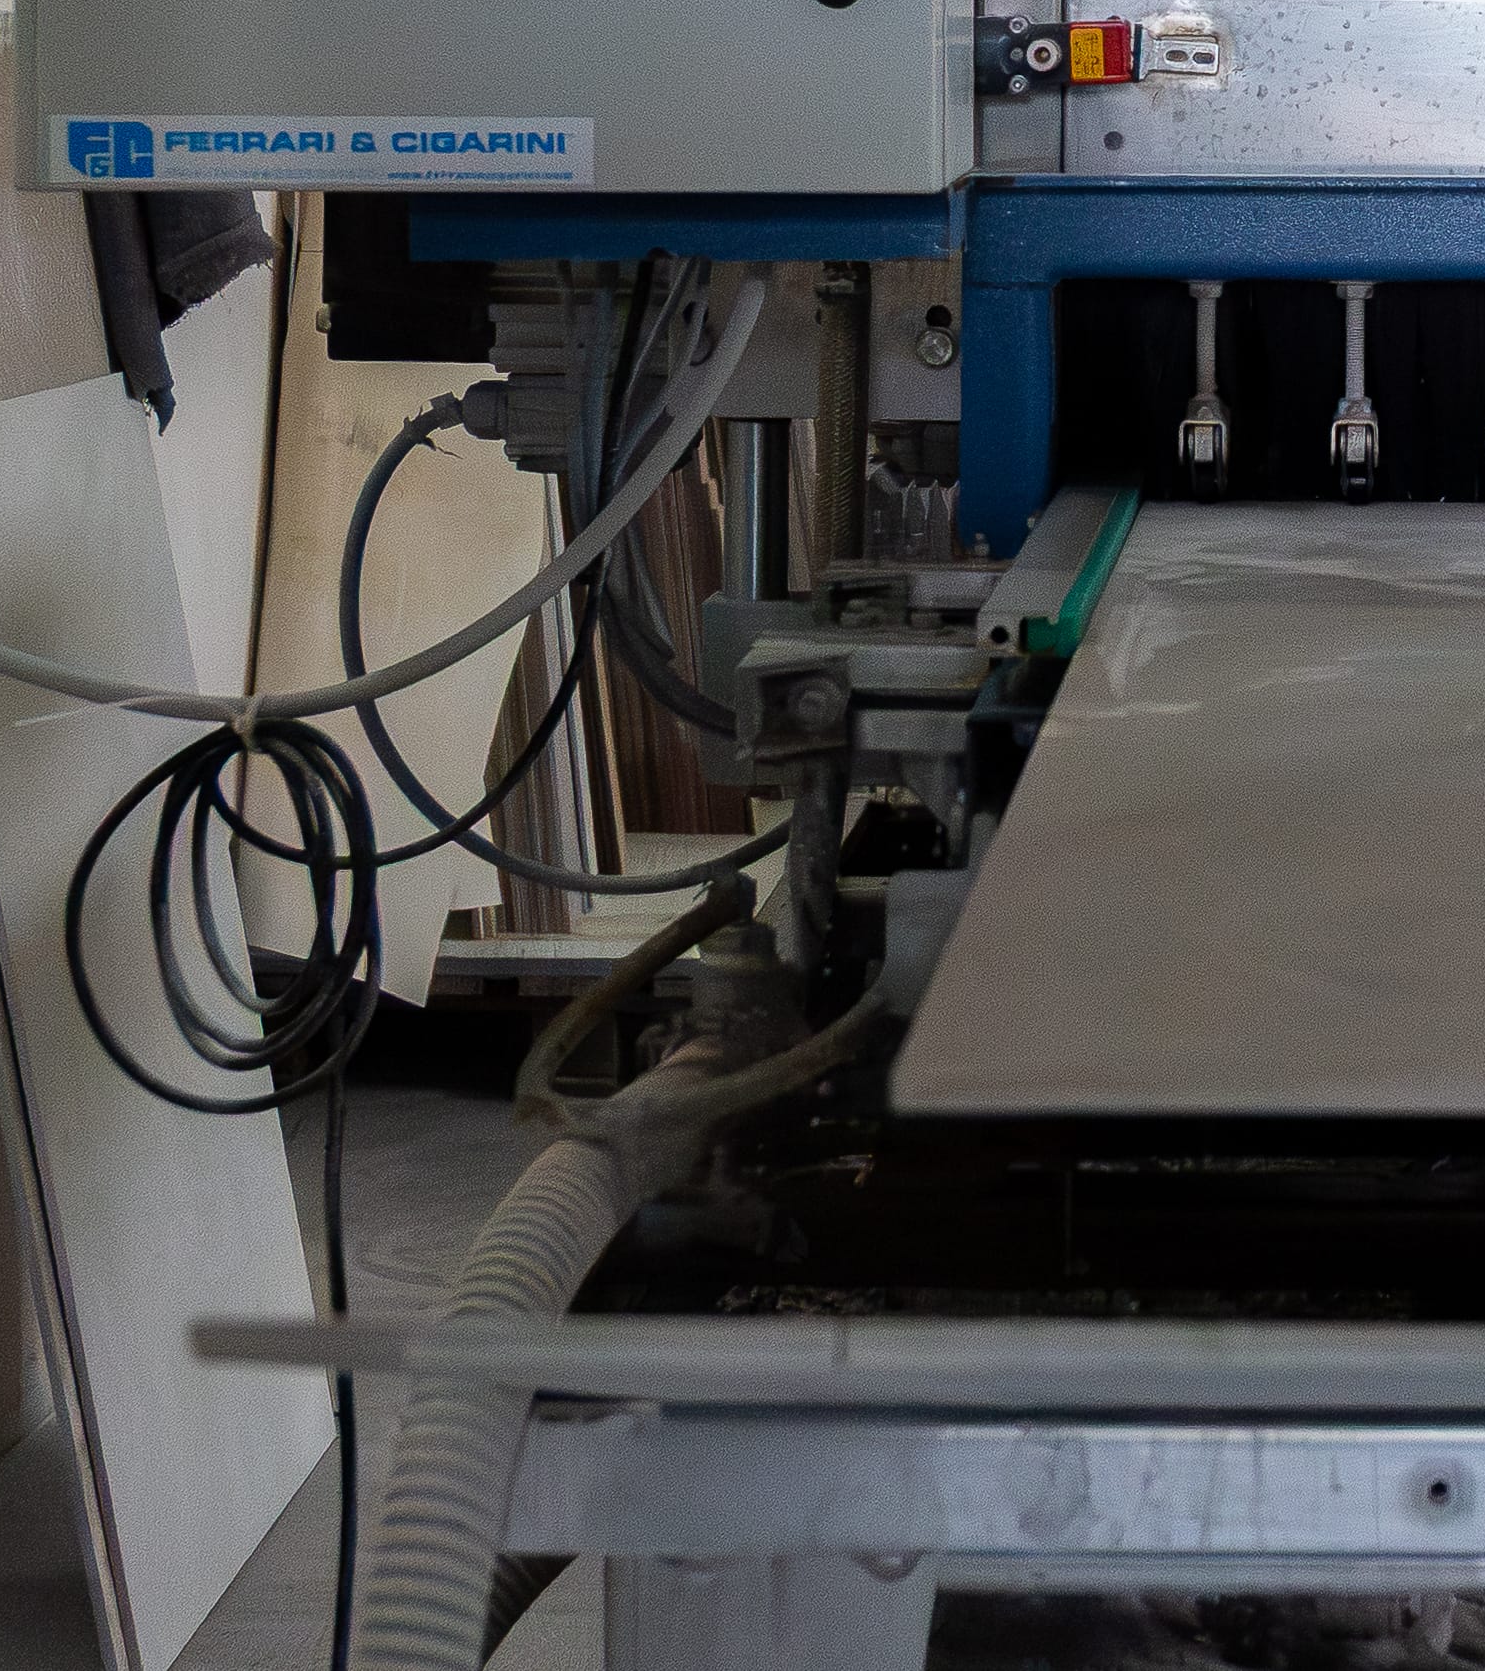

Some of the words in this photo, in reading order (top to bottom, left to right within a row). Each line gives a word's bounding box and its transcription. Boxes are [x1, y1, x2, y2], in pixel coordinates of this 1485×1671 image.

[163, 131, 336, 153] FERRARI
[350, 132, 377, 153] &
[390, 131, 567, 154] CIGARINI
